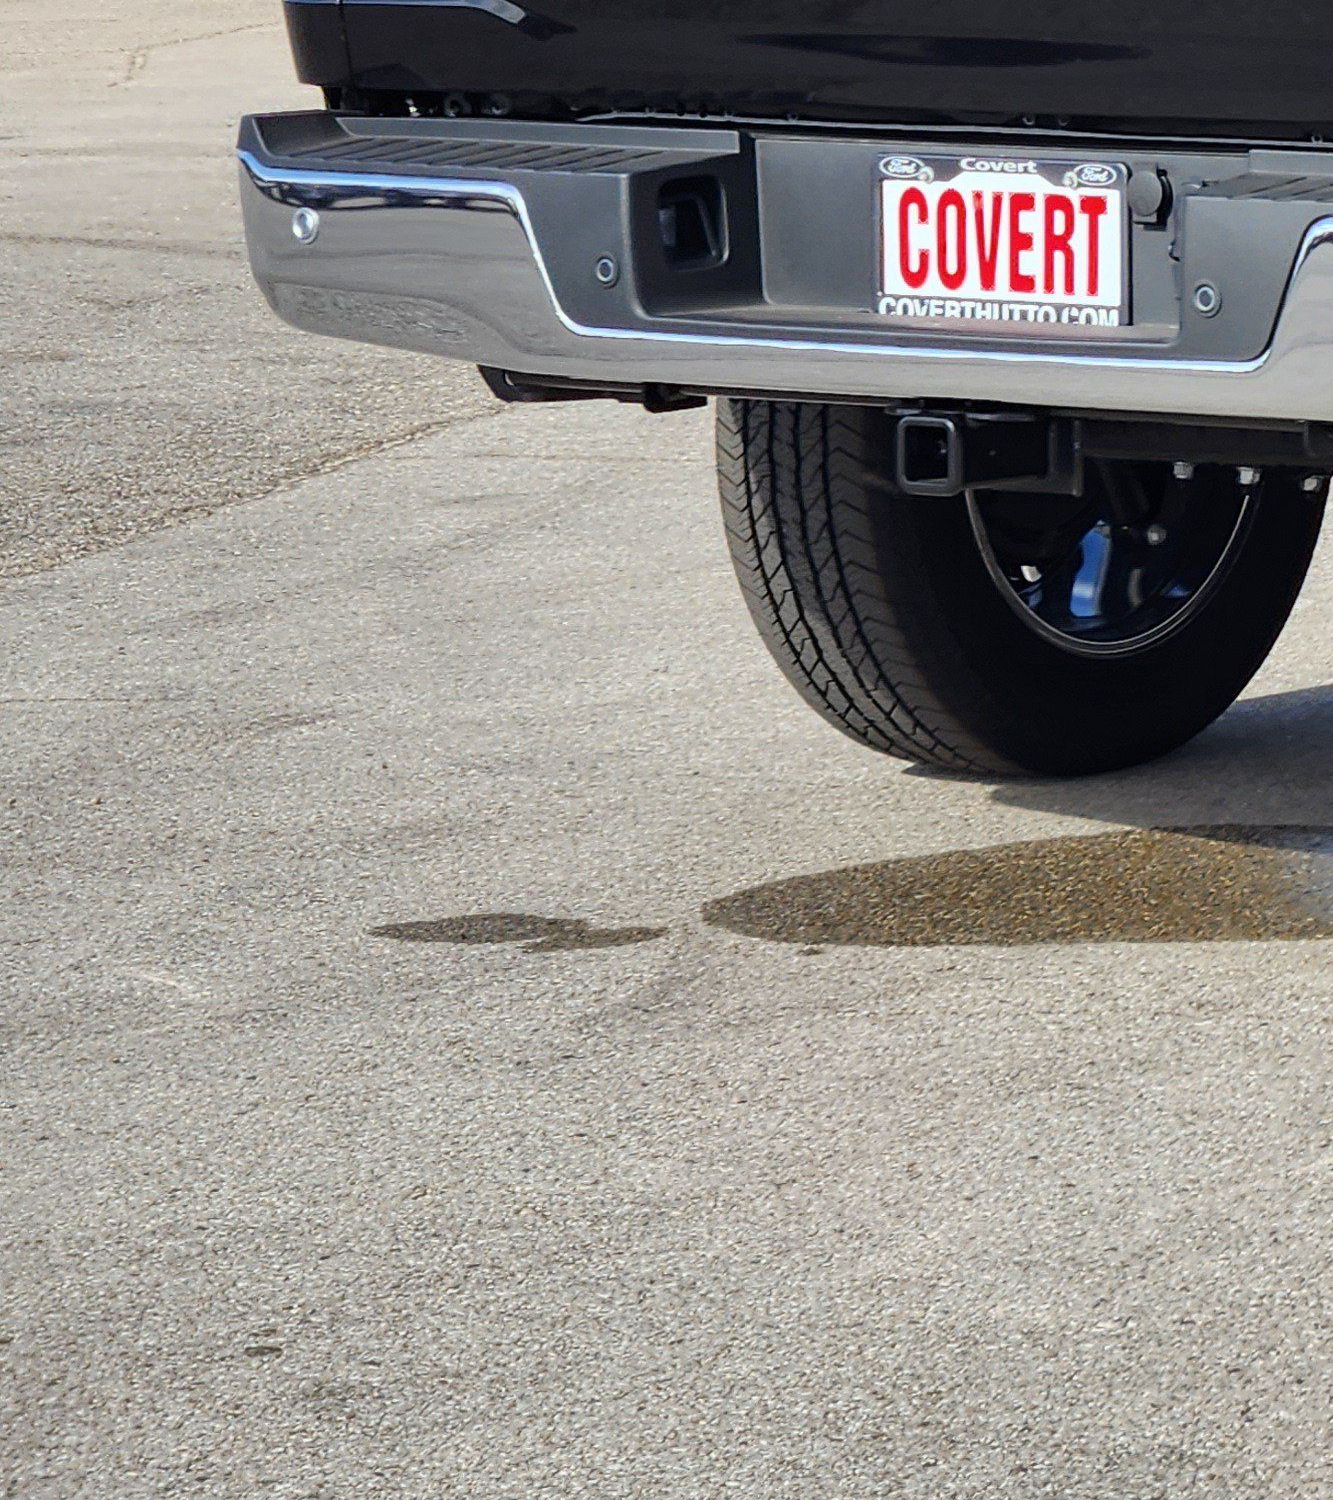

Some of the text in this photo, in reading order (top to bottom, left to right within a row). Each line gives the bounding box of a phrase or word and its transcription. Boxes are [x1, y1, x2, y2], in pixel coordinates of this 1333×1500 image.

[958, 157, 1038, 174] Covert
[899, 186, 1108, 296] COVERT
[878, 296, 1120, 327] COVERTHUTTOCOM
